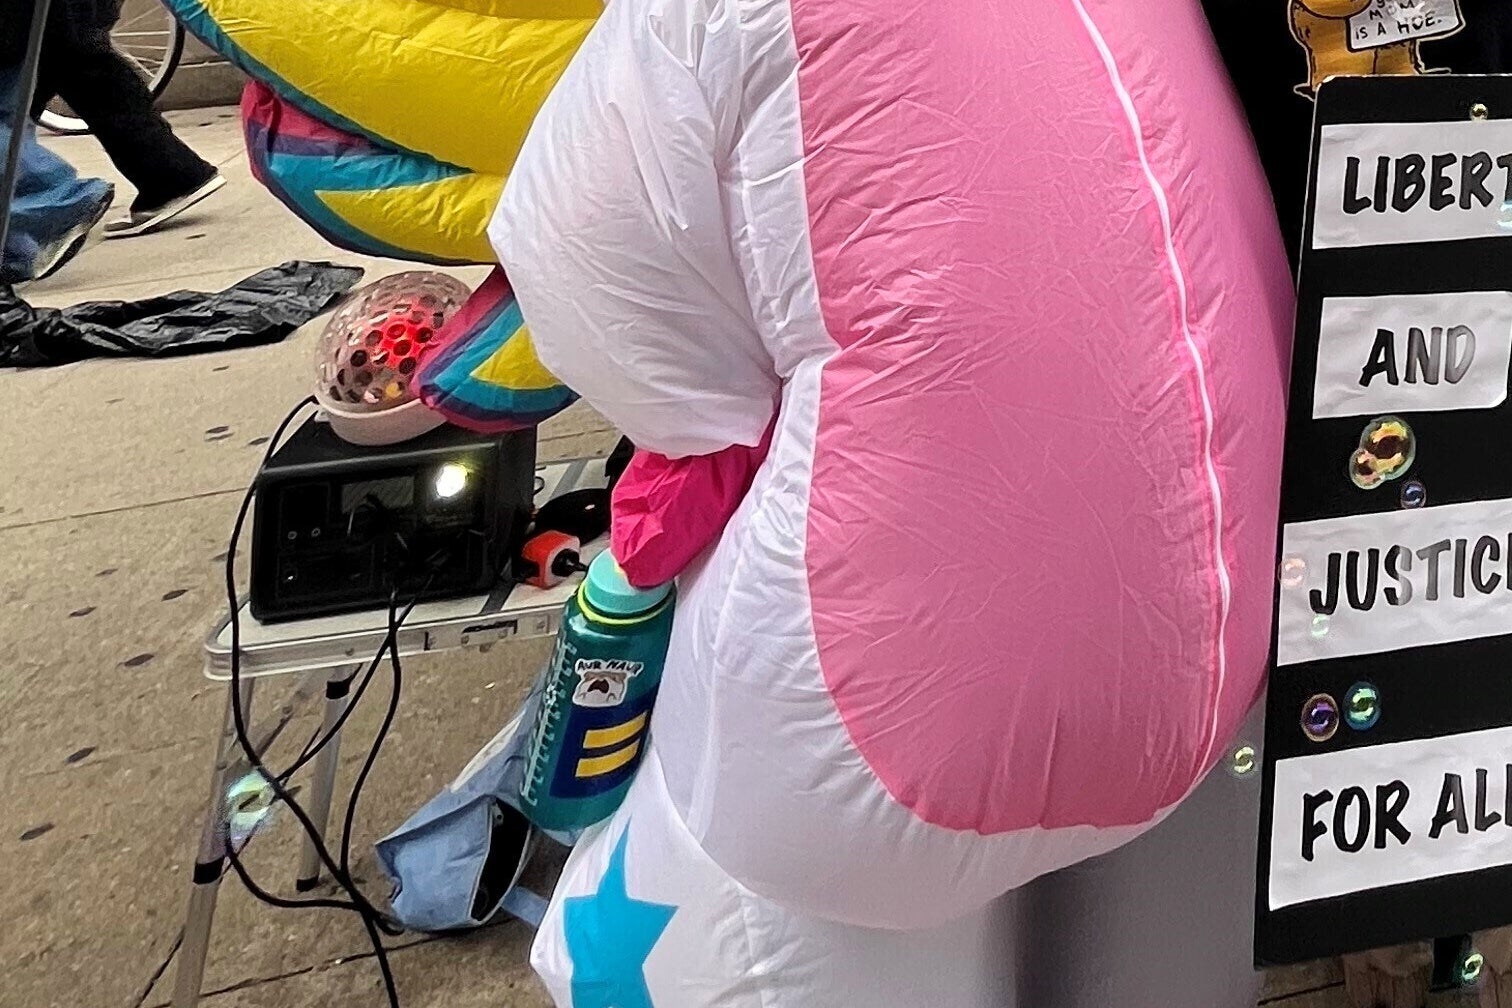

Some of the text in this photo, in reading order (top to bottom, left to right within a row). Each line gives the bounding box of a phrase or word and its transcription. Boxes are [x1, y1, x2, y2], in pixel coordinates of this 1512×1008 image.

[1369, 0, 1415, 20] MOM
[1377, 22, 1387, 36] A
[1359, 325, 1476, 387] AND
[1302, 780, 1411, 861] FOR
